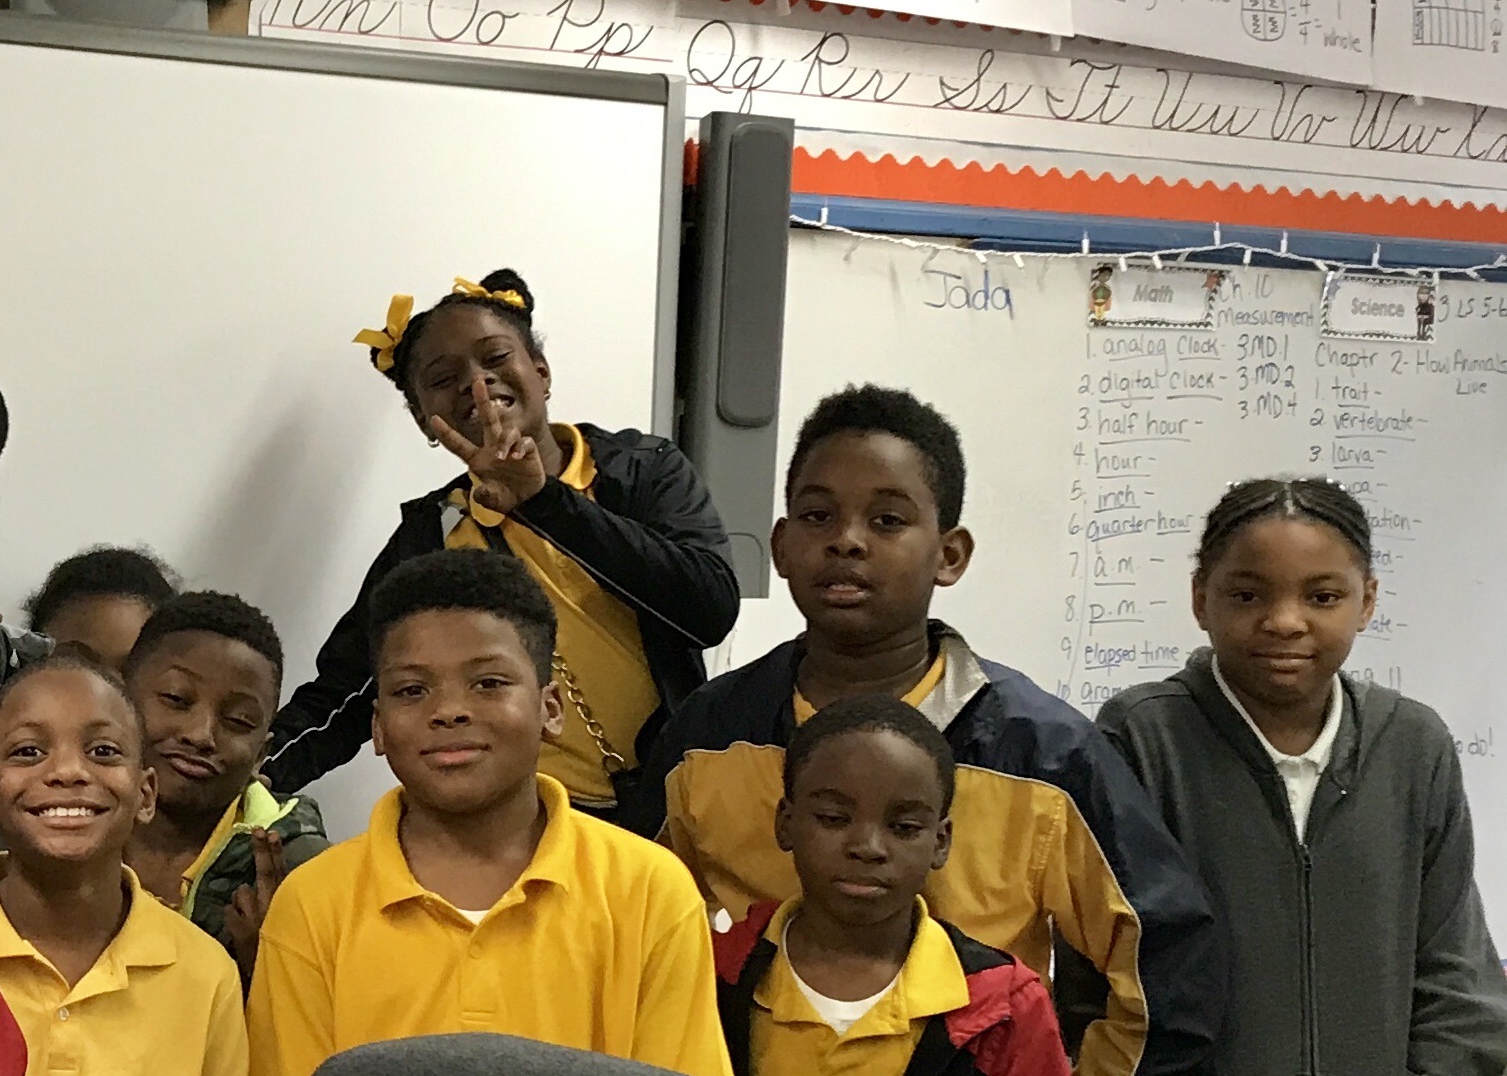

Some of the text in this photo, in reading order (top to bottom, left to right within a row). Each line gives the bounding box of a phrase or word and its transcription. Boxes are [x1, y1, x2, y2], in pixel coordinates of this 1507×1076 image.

[686, 20, 785, 115] Qq
[801, 32, 911, 102] Rr
[933, 49, 1032, 114] Ss
[1045, 58, 1134, 125] Tt
[1151, 68, 1261, 137] Uu
[1270, 80, 1337, 143] Vv
[1349, 90, 1451, 155] Ww
[923, 269, 1015, 321] Jada
[1132, 283, 1174, 304] Math
[1350, 297, 1406, 319] Science
[1102, 333, 1170, 377] analog
[1098, 370, 1162, 408] digital
[1097, 411, 1139, 437] half
[1084, 642, 1136, 677] elapsed
